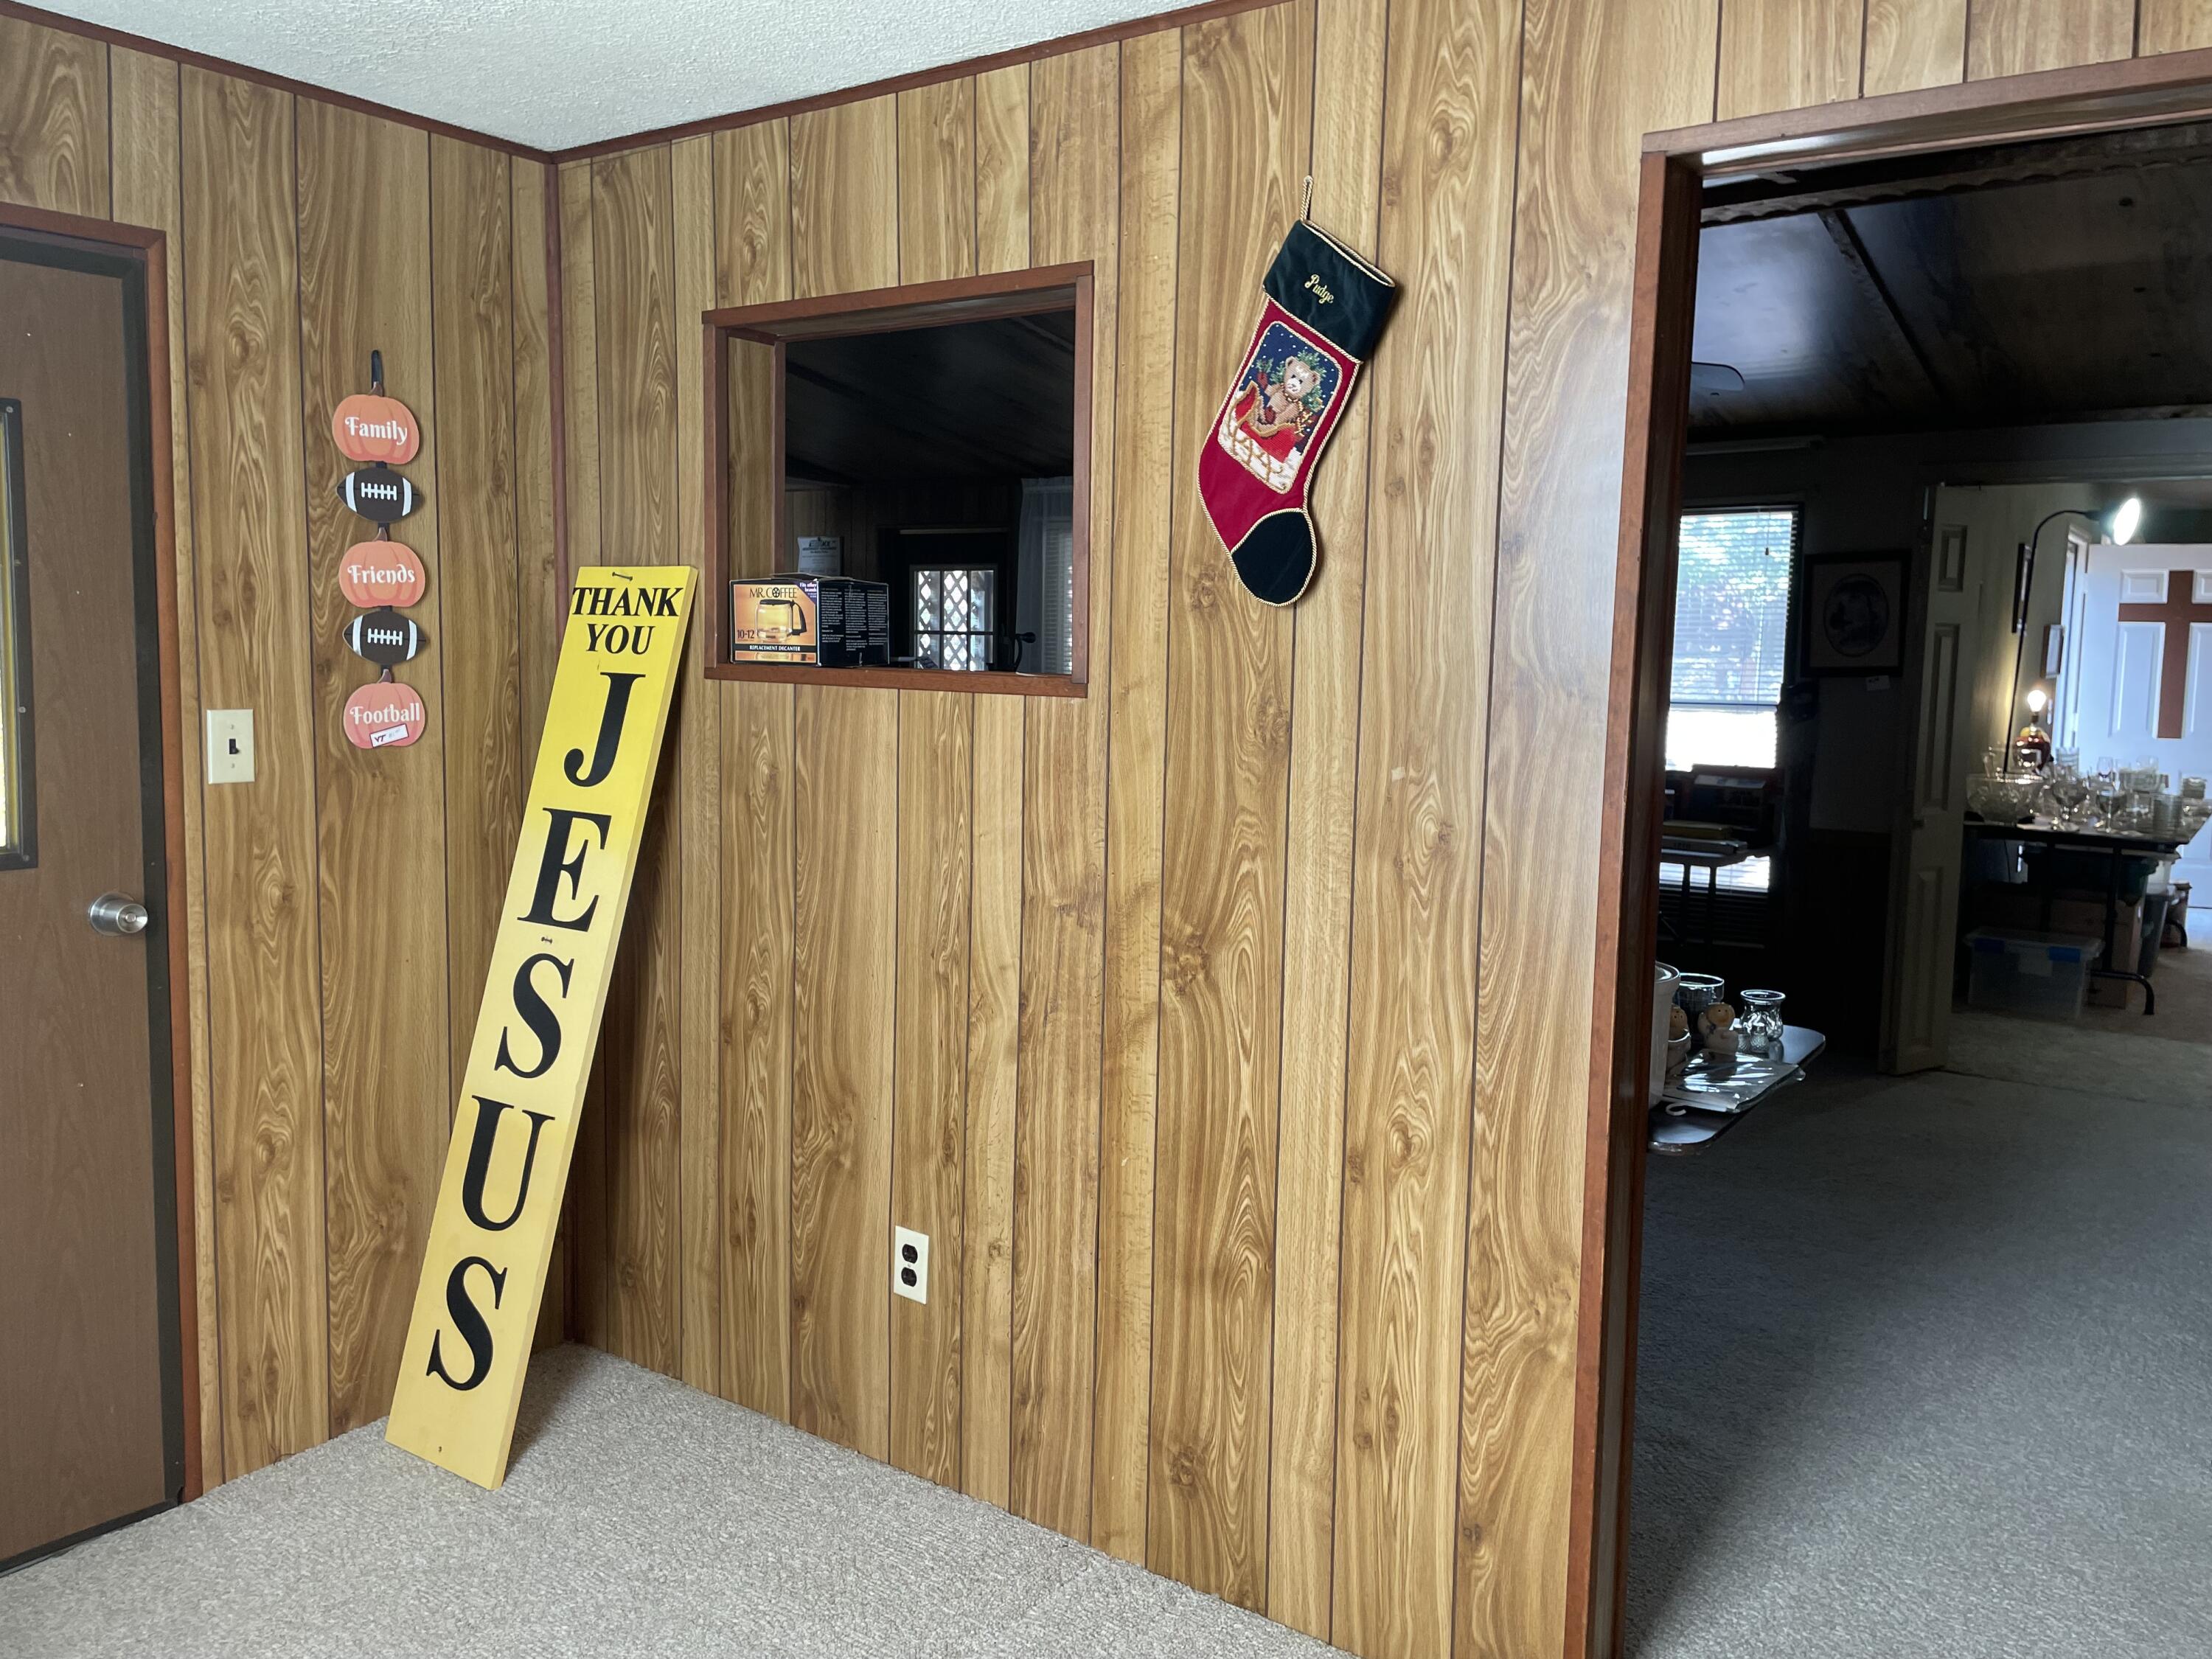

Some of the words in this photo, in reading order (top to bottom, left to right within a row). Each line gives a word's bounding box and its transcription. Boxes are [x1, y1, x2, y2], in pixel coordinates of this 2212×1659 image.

[1304, 274, 1335, 304] Pudge
[344, 416, 408, 446] Family
[347, 563, 416, 585] Friends
[571, 587, 684, 617] THANK
[749, 587, 765, 599] MR.
[766, 587, 799, 599] COFFEE
[585, 622, 656, 655] YOU
[737, 629, 755, 639] 10-12
[349, 702, 420, 726] Football
[425, 672, 647, 1391] JESUS
